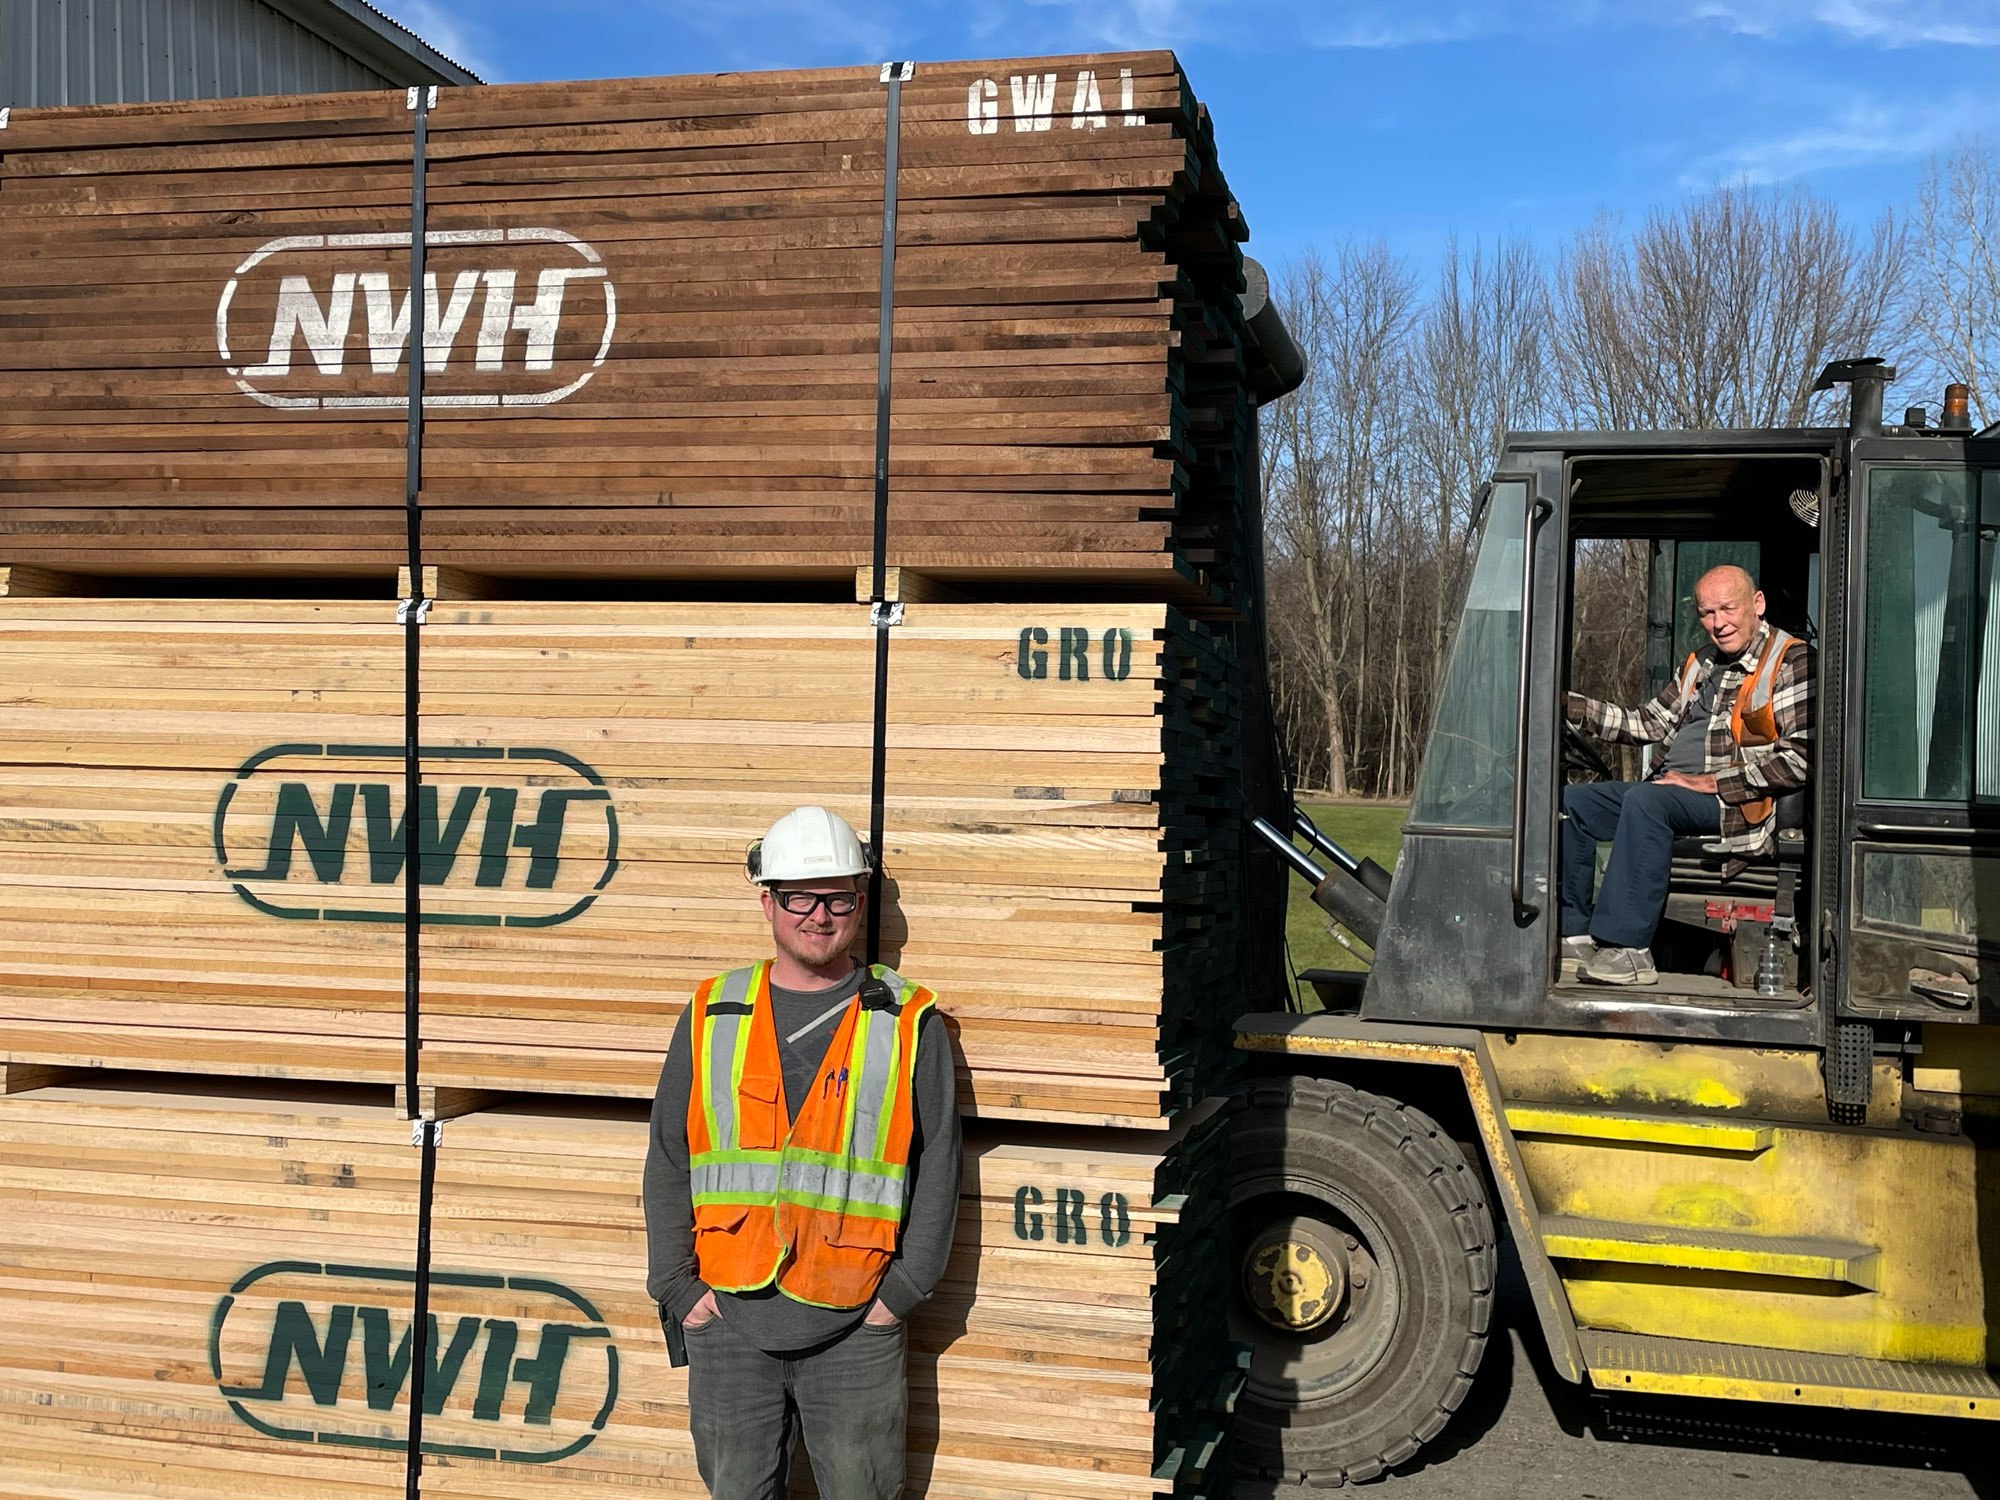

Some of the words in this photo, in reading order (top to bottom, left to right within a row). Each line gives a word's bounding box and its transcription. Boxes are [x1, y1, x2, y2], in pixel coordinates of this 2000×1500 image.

[968, 68, 1146, 135] GWAL
[243, 267, 608, 377] NWH
[1017, 627, 1132, 681] GRO
[224, 783, 612, 889] NWH
[1014, 1186, 1131, 1247] GRO
[219, 1301, 611, 1426] NWH
